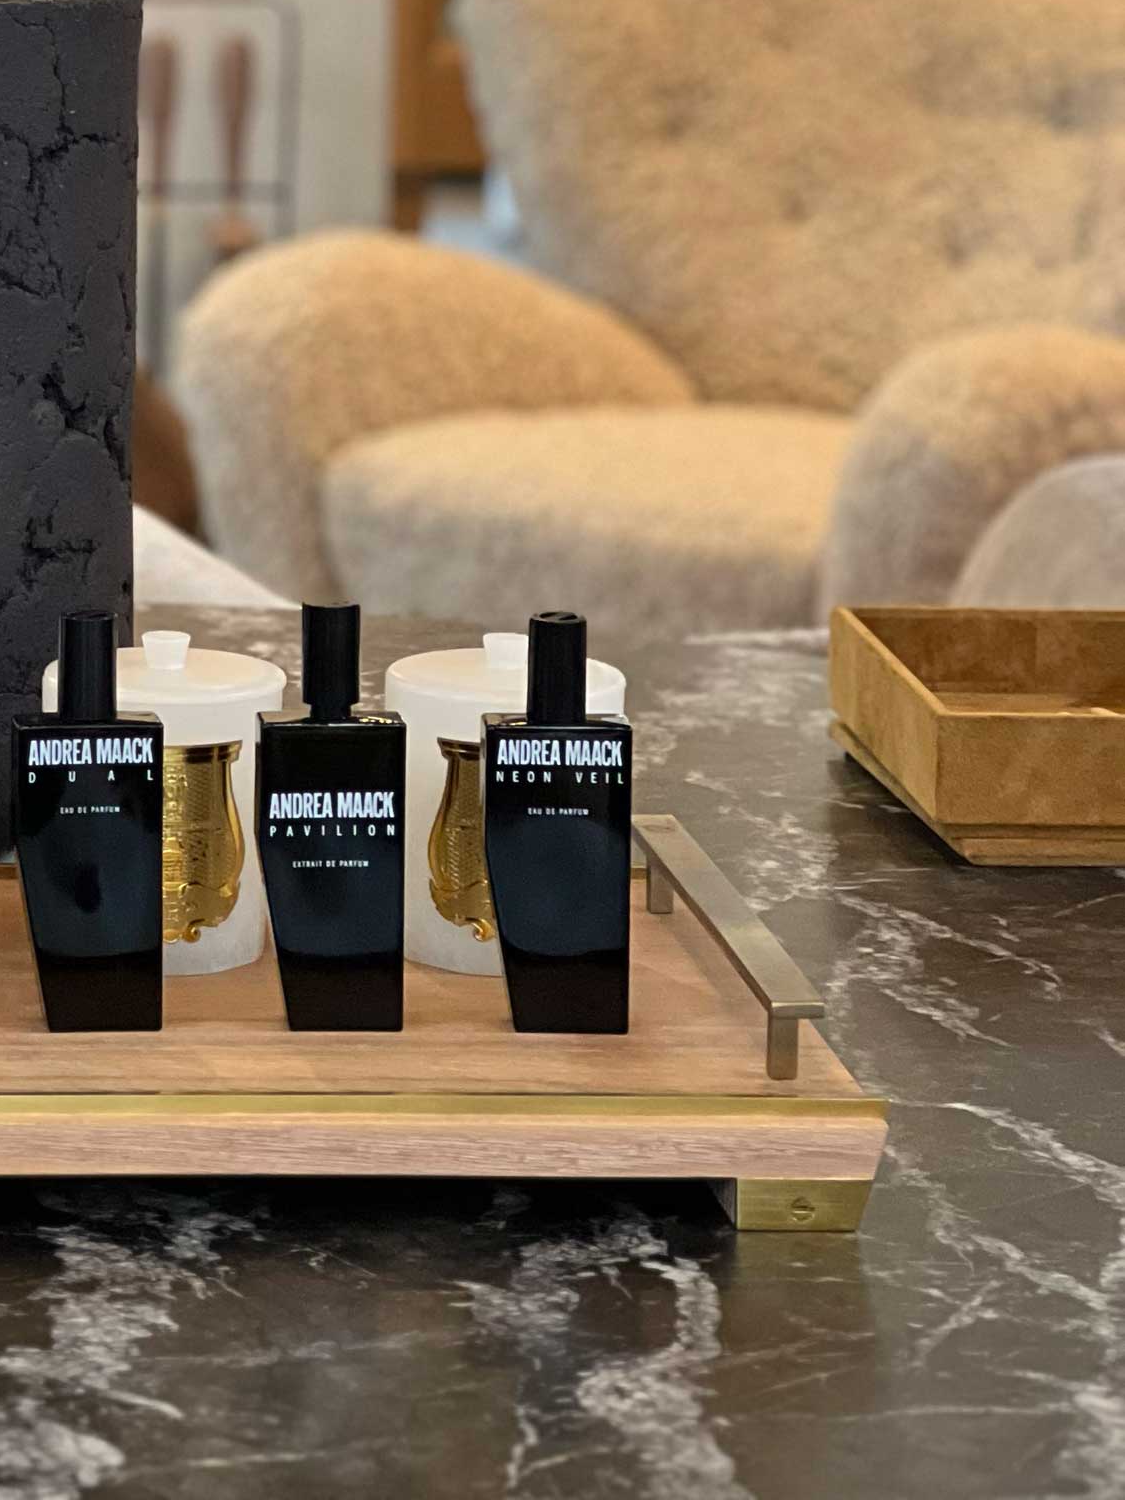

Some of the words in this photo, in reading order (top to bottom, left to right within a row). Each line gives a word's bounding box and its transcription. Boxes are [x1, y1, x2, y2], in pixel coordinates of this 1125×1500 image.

[29, 739, 92, 766] ANDREA
[97, 738, 153, 764] MAACK
[497, 739, 561, 765] ANDREA
[566, 740, 622, 766] MAACK
[28, 769, 154, 784] DUAL
[495, 770, 552, 783] NEON
[575, 771, 624, 785] VEIL
[59, 806, 75, 815] EAU
[77, 806, 87, 814] DE
[90, 805, 121, 813] PARFUM
[270, 793, 333, 819] ANDREA
[337, 792, 394, 818] MAACK
[527, 807, 543, 816] EAU
[545, 807, 556, 816] DE
[558, 808, 589, 816] PARFUM
[269, 824, 395, 837] PAVILION
[292, 860, 323, 869] EXTRAIT
[325, 859, 336, 868] DE
[338, 859, 369, 868] PARFUM
